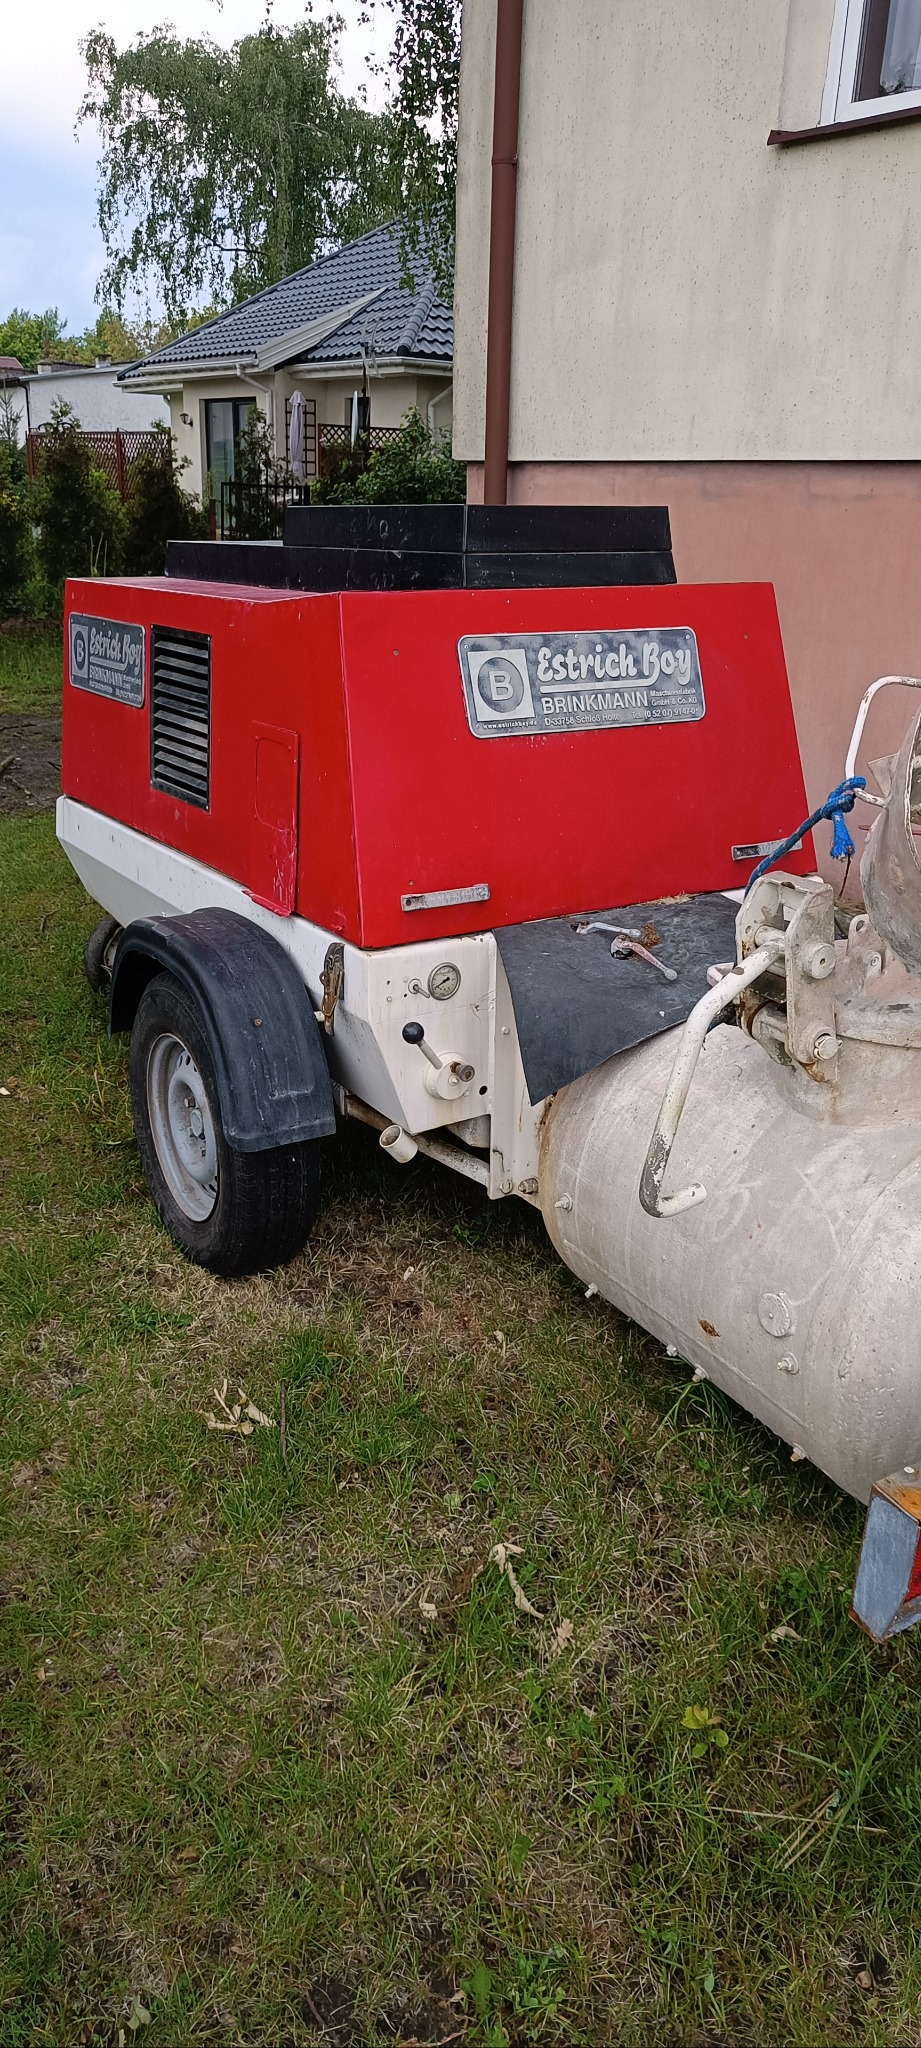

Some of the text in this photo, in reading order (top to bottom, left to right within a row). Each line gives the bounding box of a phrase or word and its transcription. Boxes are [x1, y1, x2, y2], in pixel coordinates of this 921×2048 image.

[76, 639, 84, 662] B
[90, 627, 142, 675] Estrich Boy
[537, 642, 691, 686] Estrich Boy
[488, 670, 514, 701] B
[541, 691, 648, 714] BRINKMANN
[651, 699, 670, 707] GmbH
[652, 708, 661, 718] 52
[544, 717, 575, 727] D-33758
